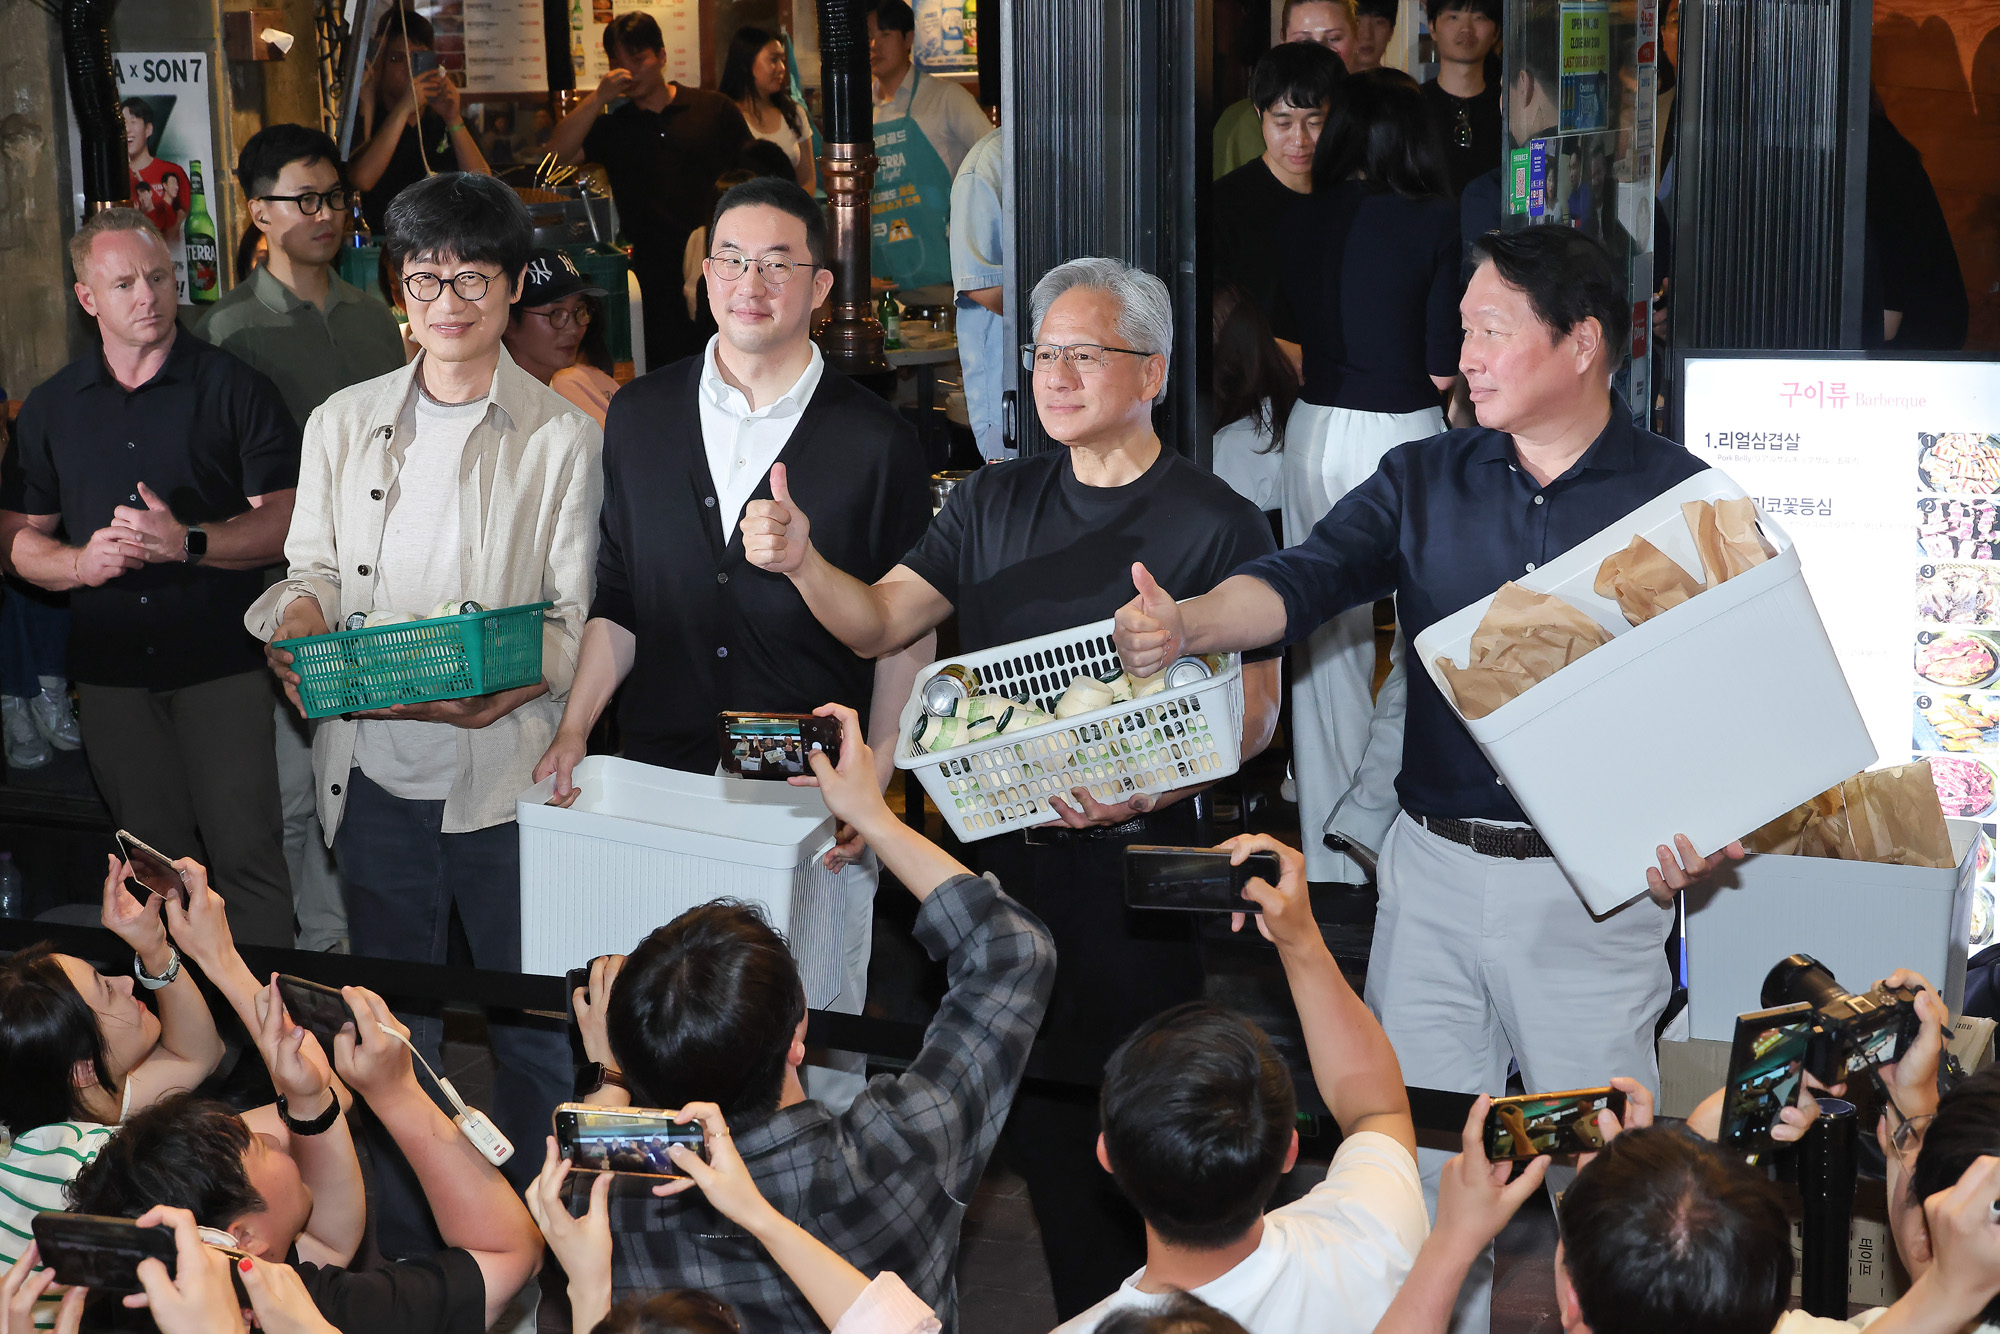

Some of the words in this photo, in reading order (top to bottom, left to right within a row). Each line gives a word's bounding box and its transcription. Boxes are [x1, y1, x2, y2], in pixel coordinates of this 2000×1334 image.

[186, 244, 217, 262] TERRA
[1780, 380, 1850, 409] 구이류
[1855, 392, 1927, 410] Barberque
[1704, 431, 1801, 451] 1.리얼삼겹살
[1717, 454, 1733, 462] Pork
[1858, 1237, 1873, 1276] 테이프
